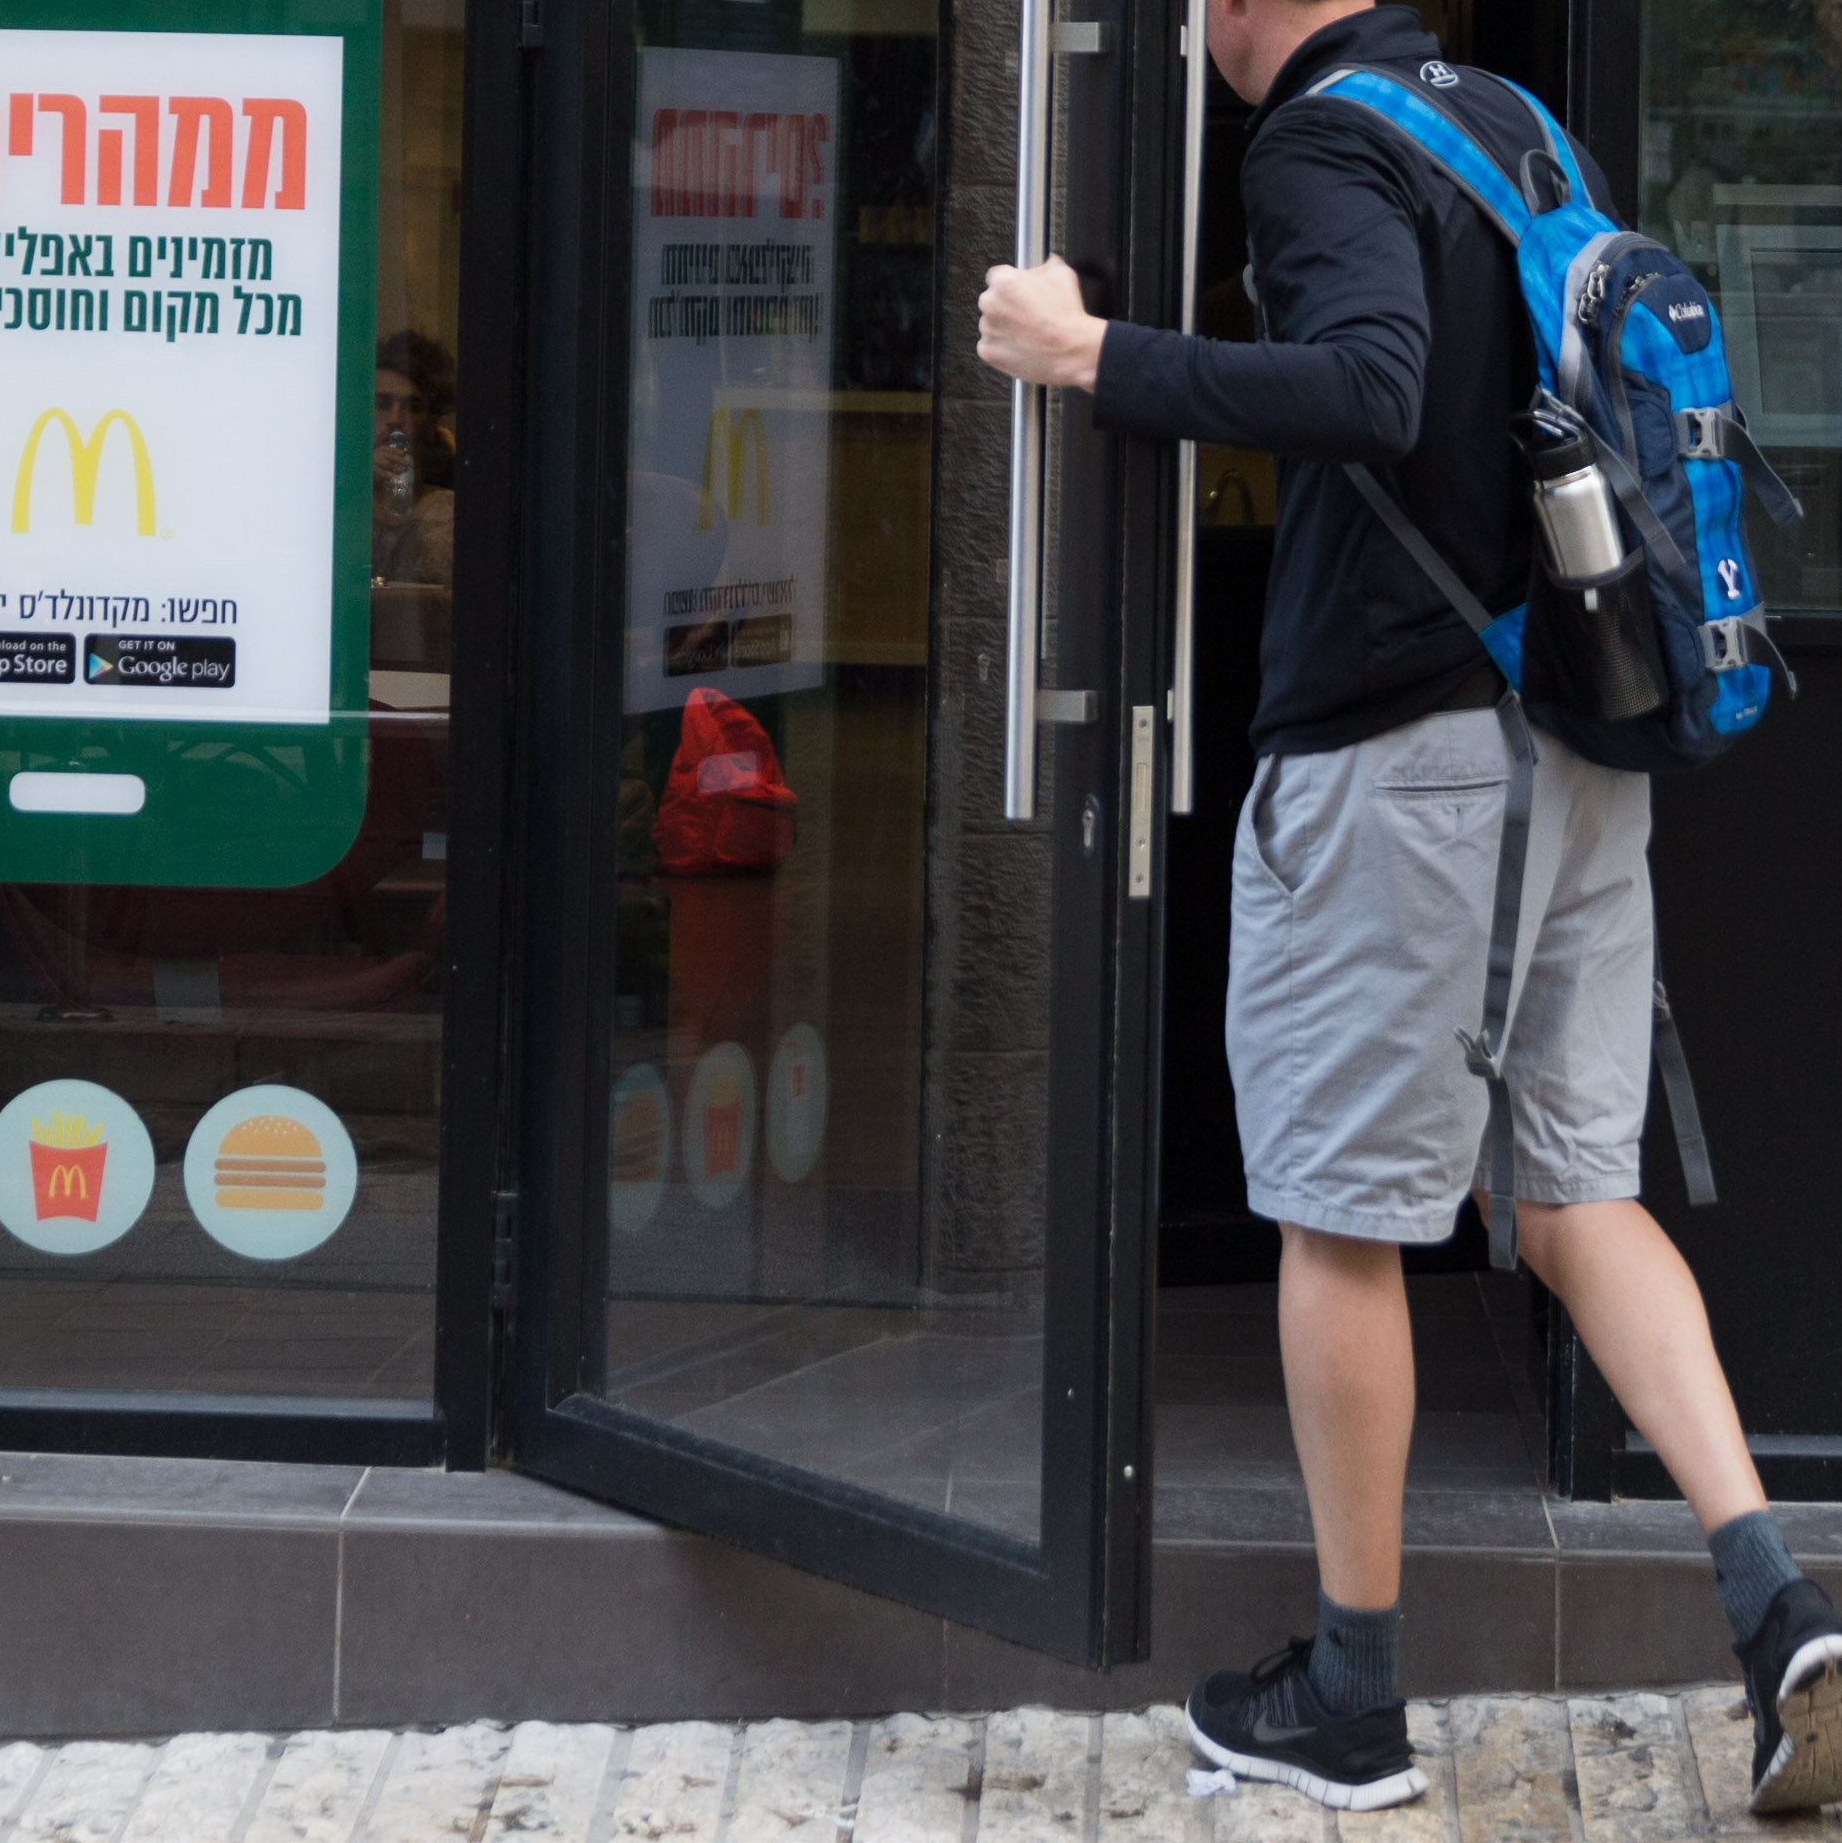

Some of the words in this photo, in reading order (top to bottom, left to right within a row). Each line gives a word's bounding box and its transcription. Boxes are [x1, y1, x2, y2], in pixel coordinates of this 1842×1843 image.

[128, 235, 273, 281] מזמינים
[123, 289, 220, 343] מקום
[232, 285, 303, 336] מכל
[19, 588, 150, 628] מקדונלד'ס
[160, 596, 238, 624] חפשו:
[29, 641, 44, 651] on
[48, 640, 67, 652] the
[118, 639, 141, 651] GET
[143, 639, 155, 651] IT
[157, 639, 176, 652] ON
[13, 654, 68, 675] Store
[118, 656, 189, 682] Google
[191, 658, 231, 682] play
